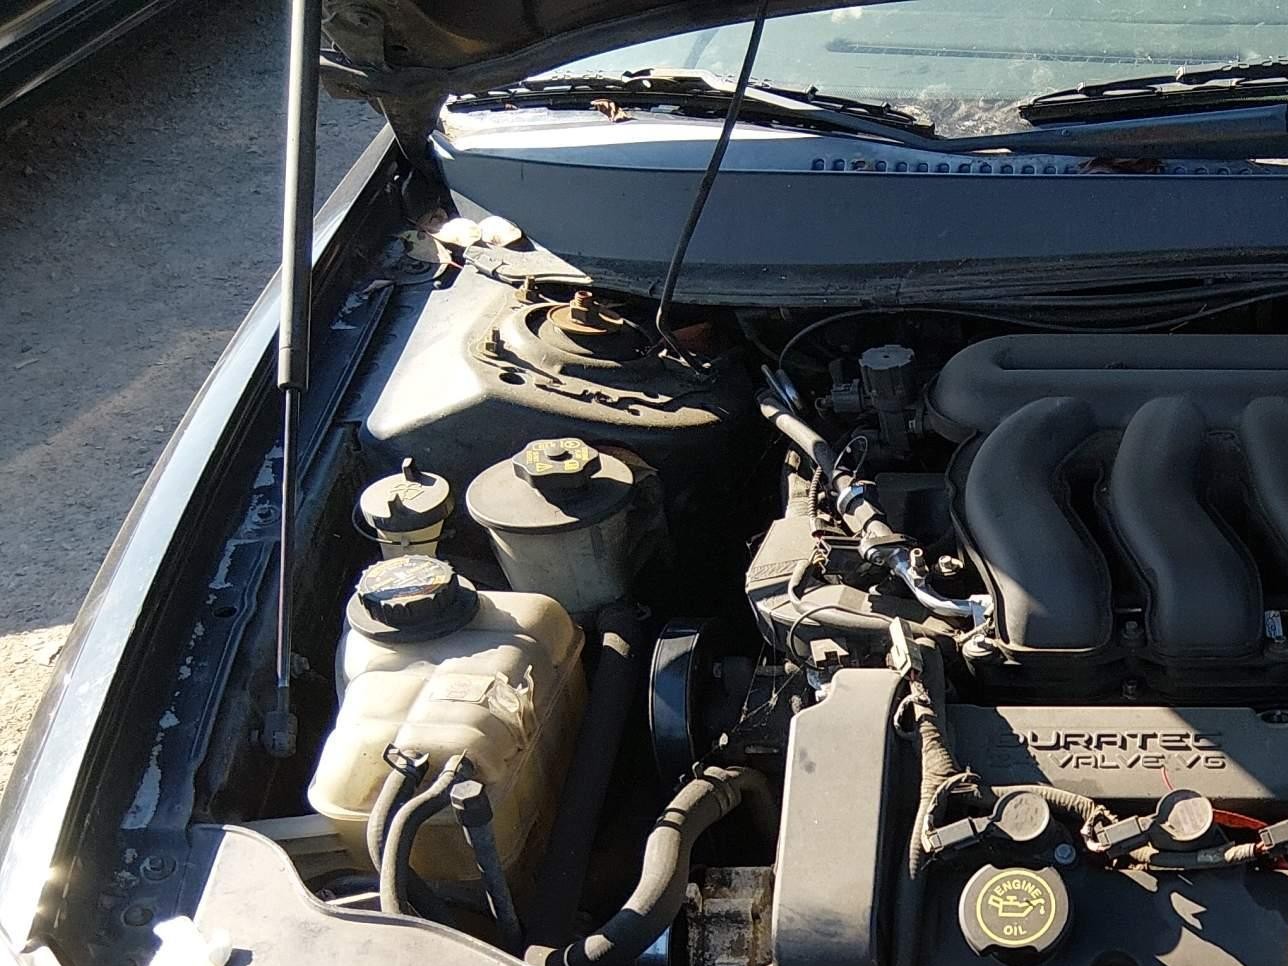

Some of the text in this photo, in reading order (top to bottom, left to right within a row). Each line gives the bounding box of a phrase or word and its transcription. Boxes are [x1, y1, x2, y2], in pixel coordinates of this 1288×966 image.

[1050, 753, 1167, 770] VALVE
[1175, 753, 1227, 769] V6
[993, 879, 1042, 899] ENGINE
[1003, 924, 1027, 936] OIL
